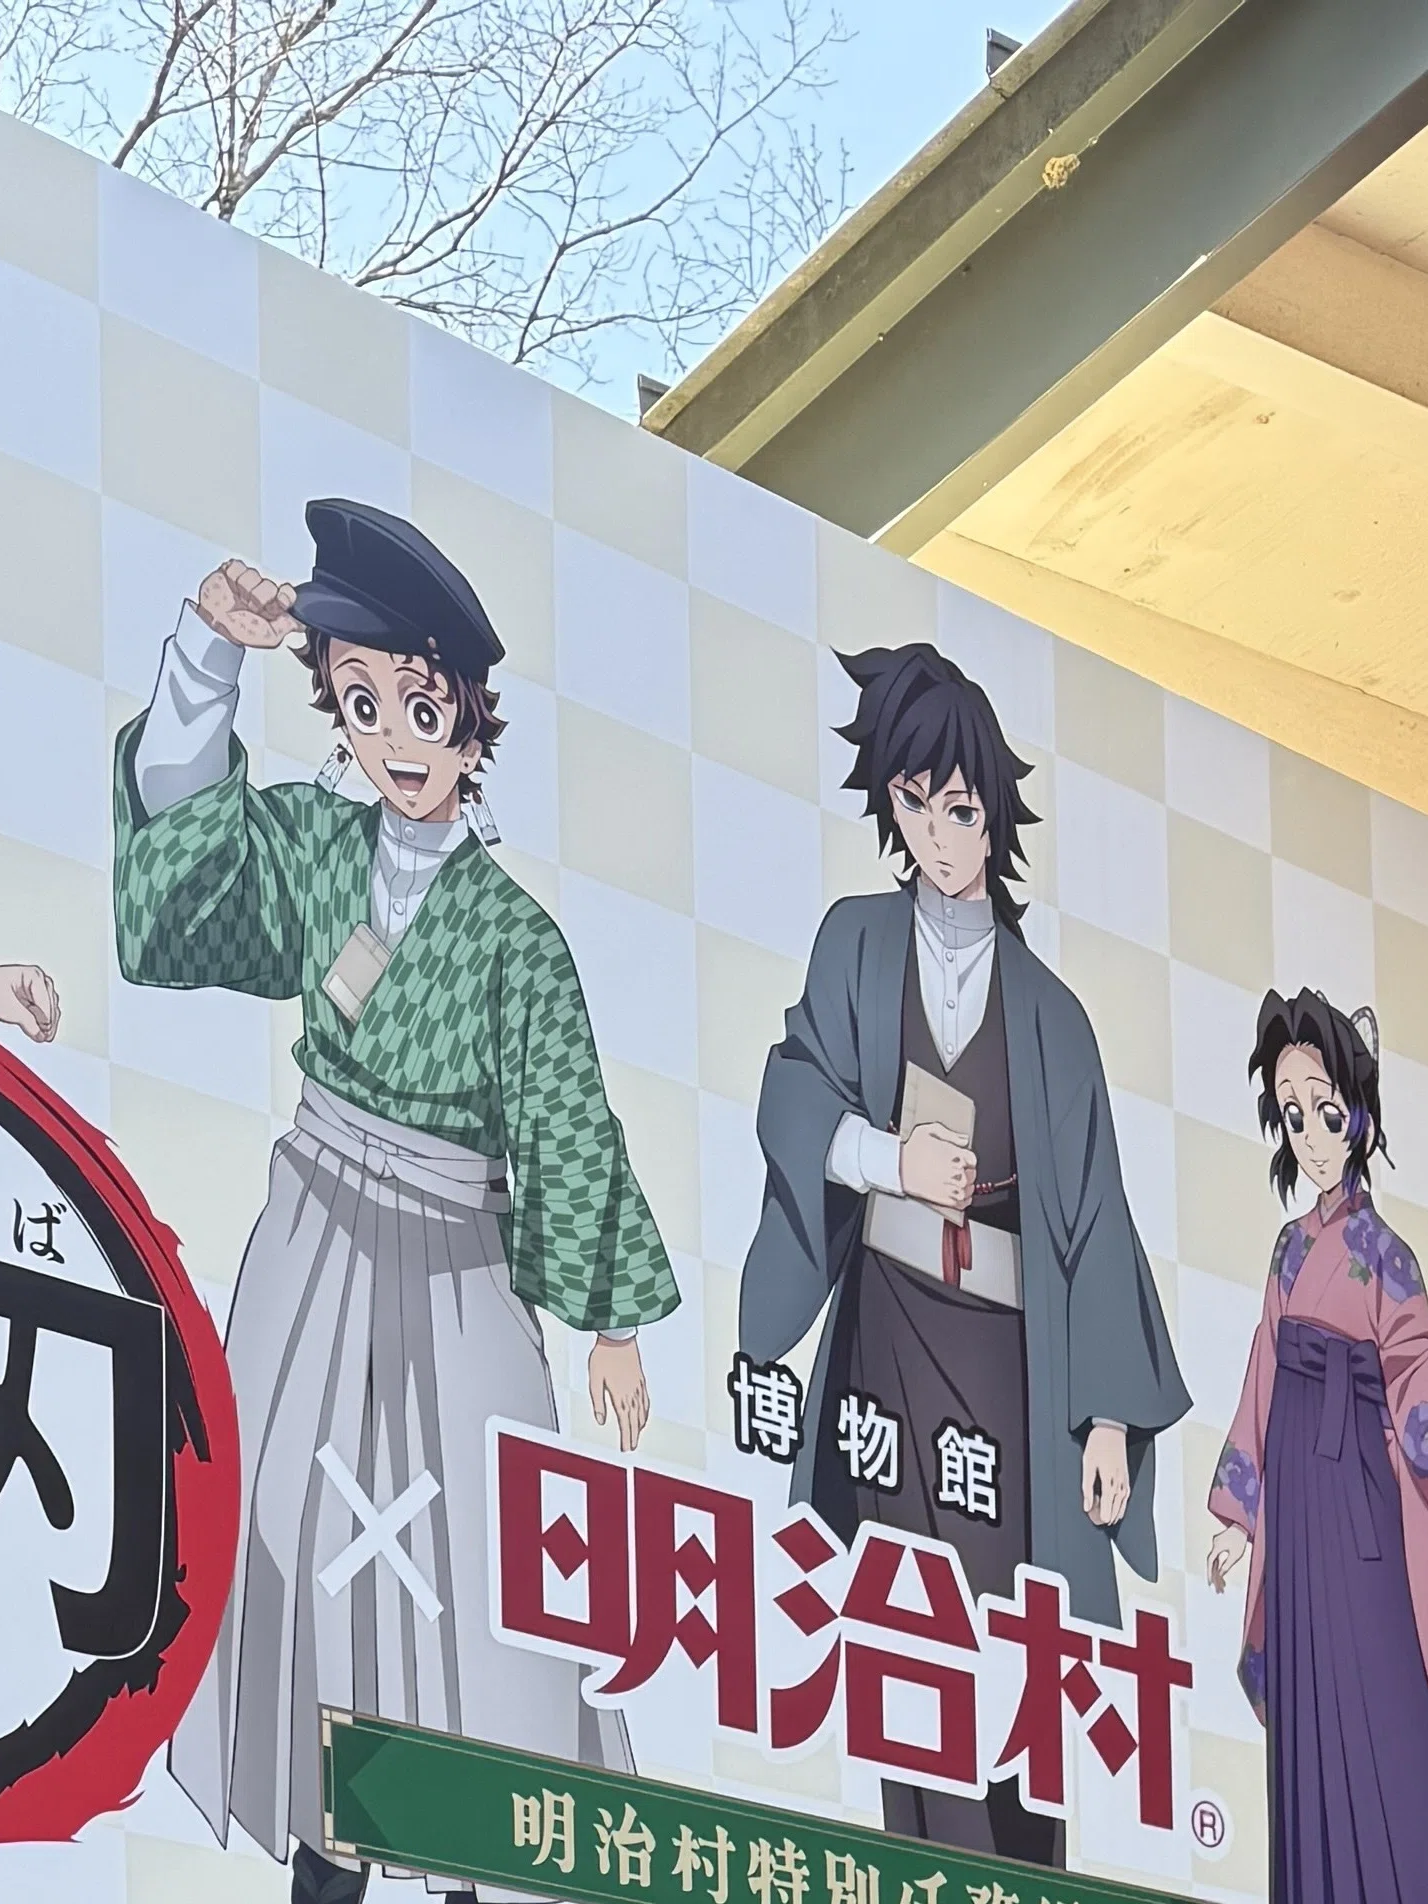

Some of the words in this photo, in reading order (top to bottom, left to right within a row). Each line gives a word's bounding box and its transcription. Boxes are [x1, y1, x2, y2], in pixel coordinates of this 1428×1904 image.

[734, 1360, 998, 1518] 博物館
[497, 1431, 1193, 1832] 明治村
